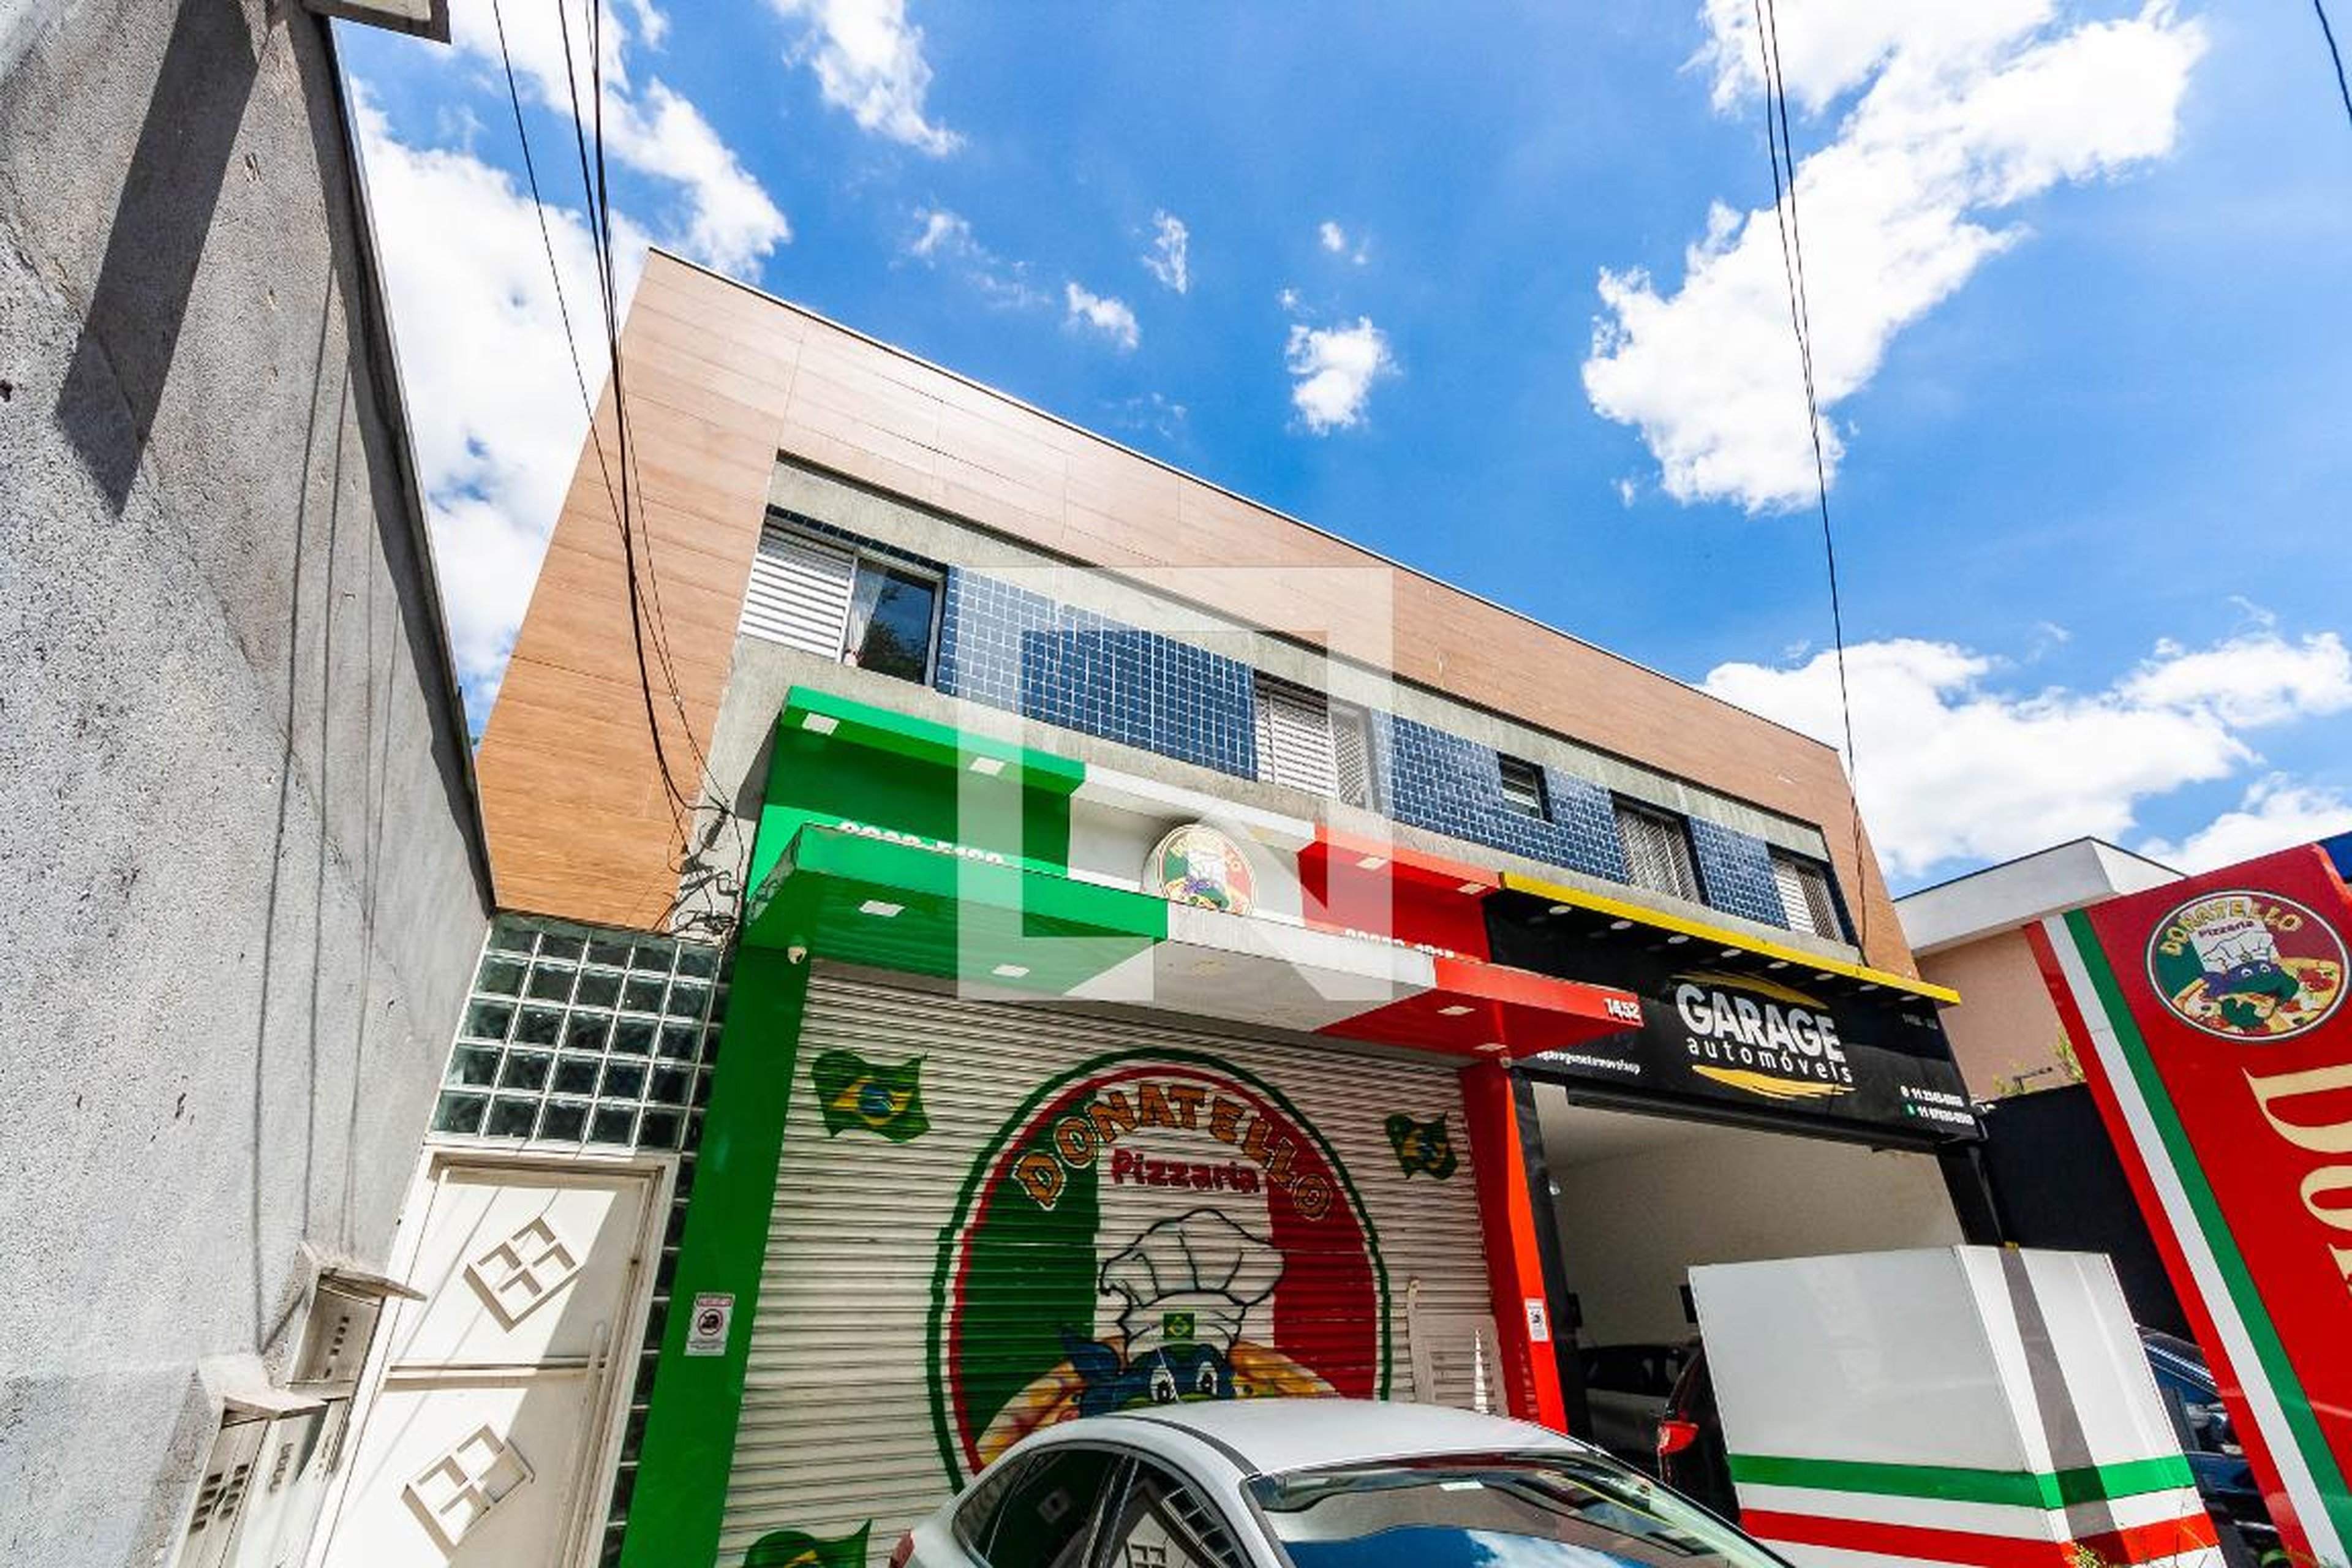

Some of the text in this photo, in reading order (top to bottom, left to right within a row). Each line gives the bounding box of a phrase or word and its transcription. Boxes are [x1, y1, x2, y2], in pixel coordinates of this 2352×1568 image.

[2159, 899, 2302, 956] DONATELLO
[1604, 997, 1641, 1020] 1452
[1675, 983, 1846, 1063] GARAGE
[1686, 1036, 1853, 1083] automóveis
[1012, 1084, 1332, 1219] DONATELLO
[1110, 1147, 1261, 1194] Pizzaria
